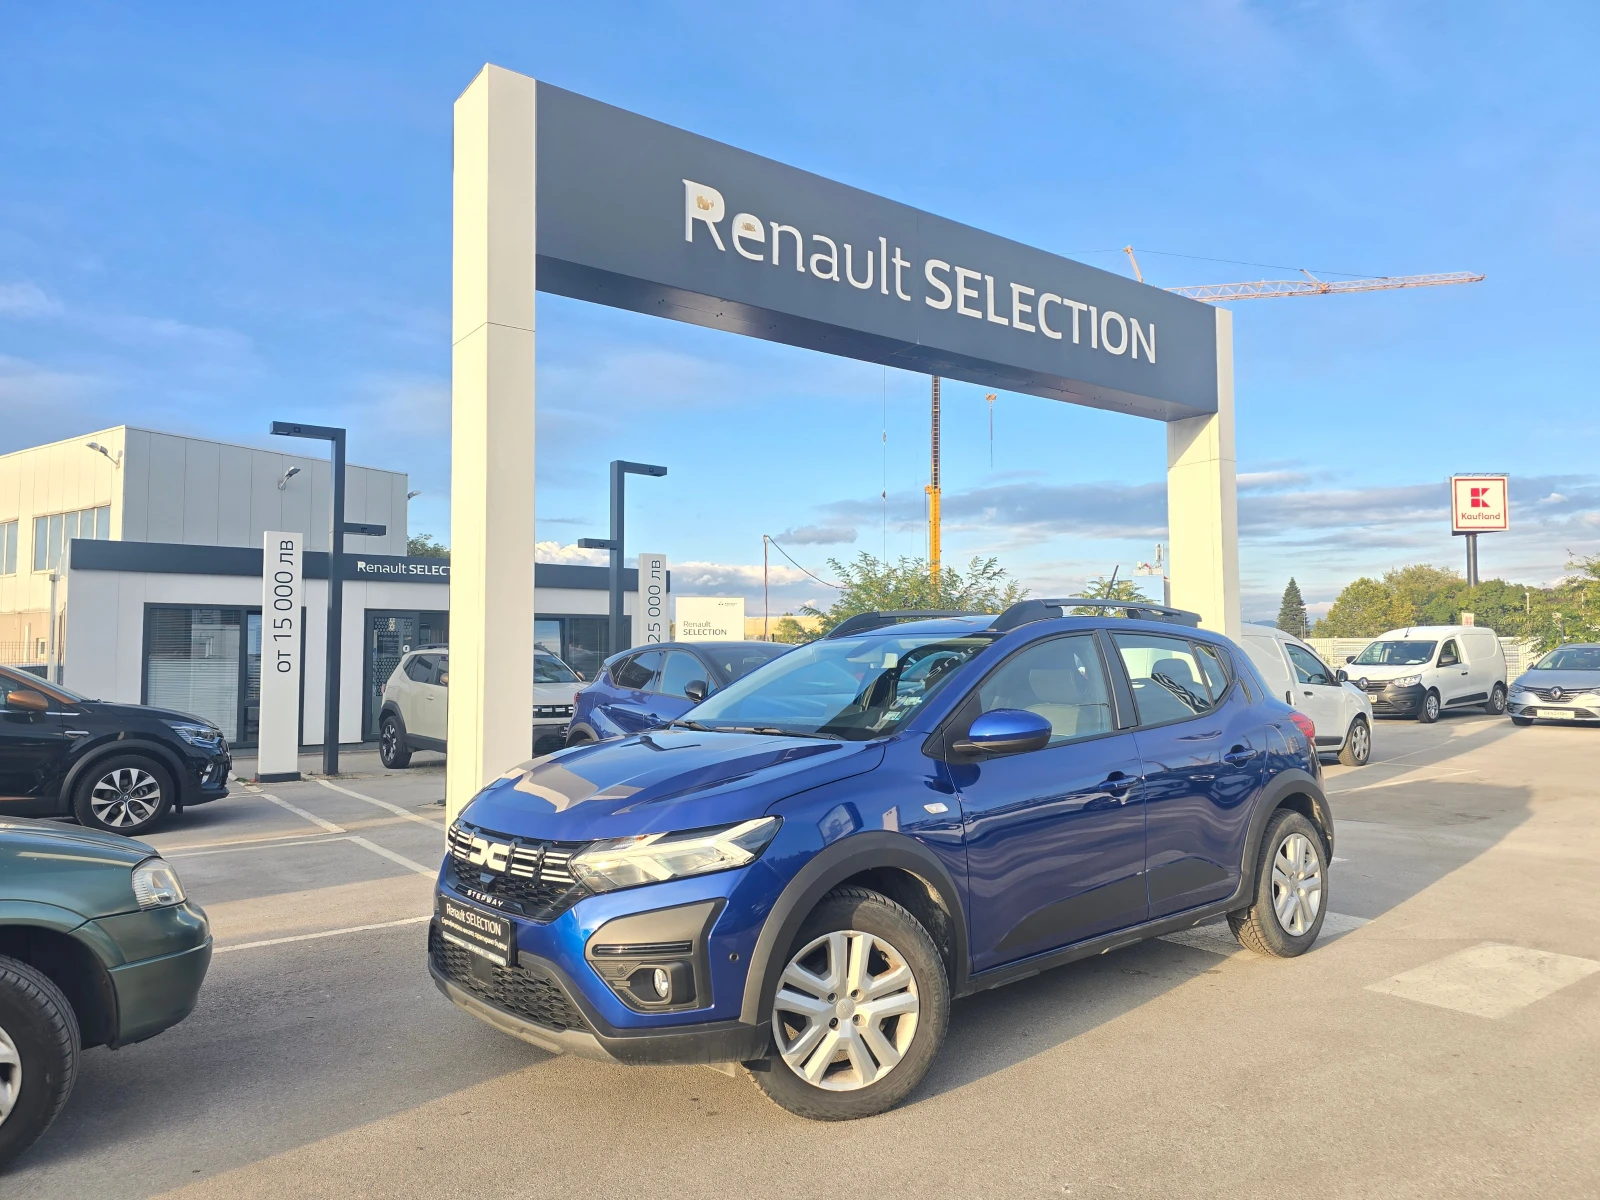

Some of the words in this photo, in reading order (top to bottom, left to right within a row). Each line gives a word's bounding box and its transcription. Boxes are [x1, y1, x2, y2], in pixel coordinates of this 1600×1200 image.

[682, 179, 911, 302] Renault
[924, 258, 1156, 364] SELECTION
[1461, 512, 1501, 520] Kaufland
[357, 561, 407, 574] Renault
[409, 564, 451, 576] SELEC
[273, 571, 293, 611] 000
[647, 585, 661, 617] 000
[273, 618, 292, 642] 15
[647, 622, 661, 643] 25
[683, 620, 712, 628] Renault
[467, 889, 504, 907] STEPWAY
[446, 903, 465, 922] Renault
[466, 912, 502, 937] SELECTION
